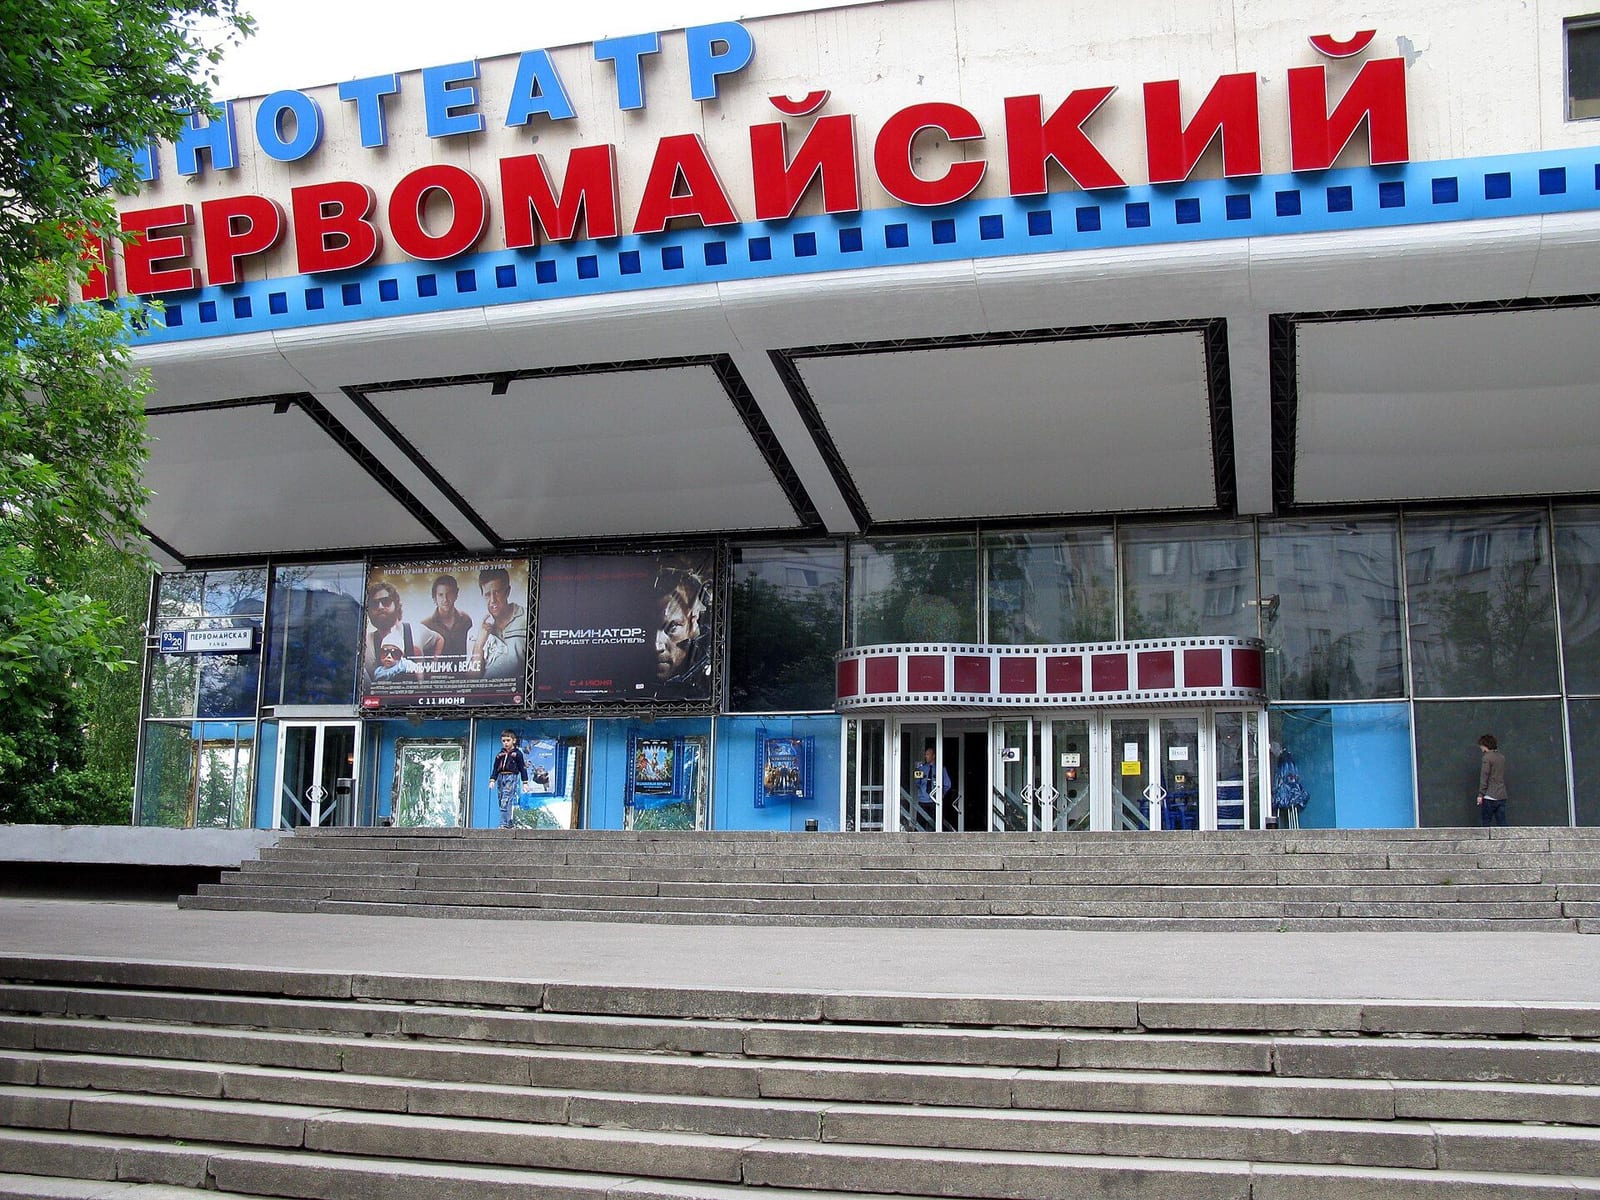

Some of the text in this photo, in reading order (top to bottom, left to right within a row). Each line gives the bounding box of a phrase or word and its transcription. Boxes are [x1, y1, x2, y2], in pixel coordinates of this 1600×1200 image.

[540, 628, 646, 639] ТЕРМИНАТОР:
[592, 637, 646, 645] СПАСИТЕЛЬ
[418, 697, 465, 705] С 11 ИЮНЯ
